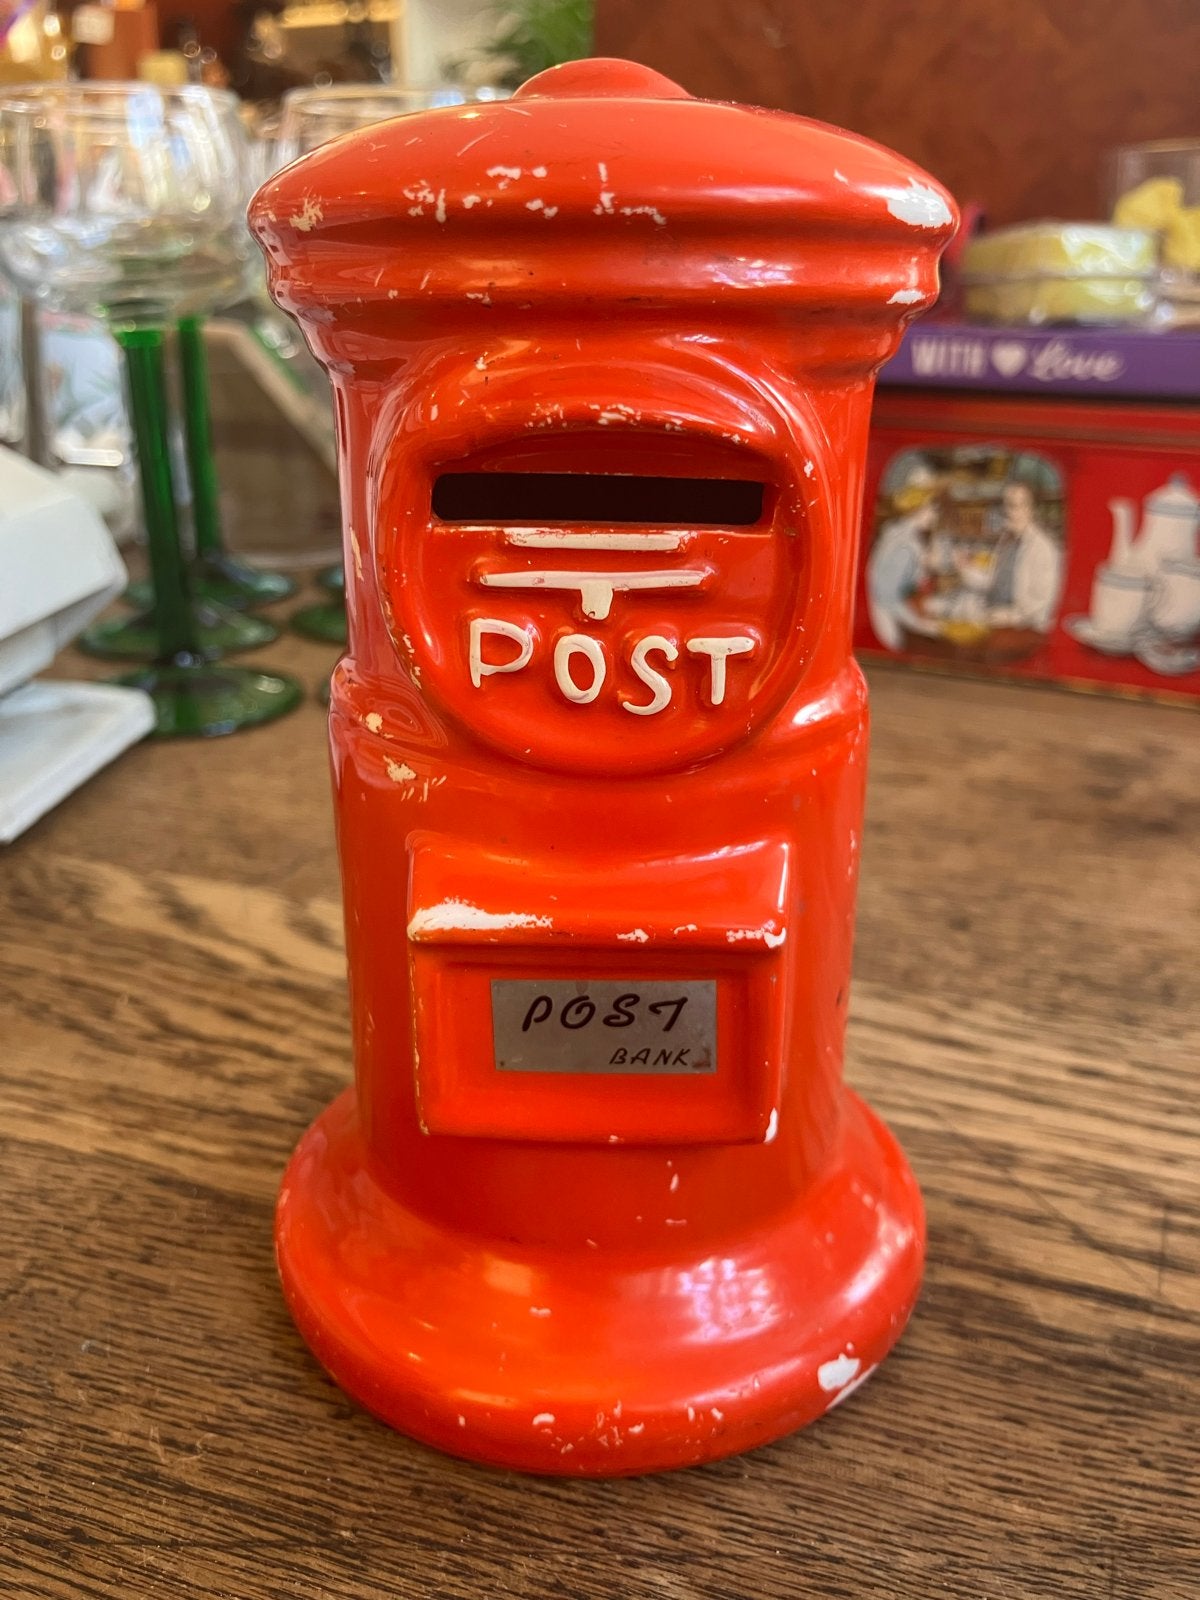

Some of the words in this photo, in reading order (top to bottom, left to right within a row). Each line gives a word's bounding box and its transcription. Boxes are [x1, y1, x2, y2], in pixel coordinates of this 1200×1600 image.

[469, 617, 755, 716] POST
[522, 993, 688, 1032] POST
[609, 1047, 690, 1066] BANK
